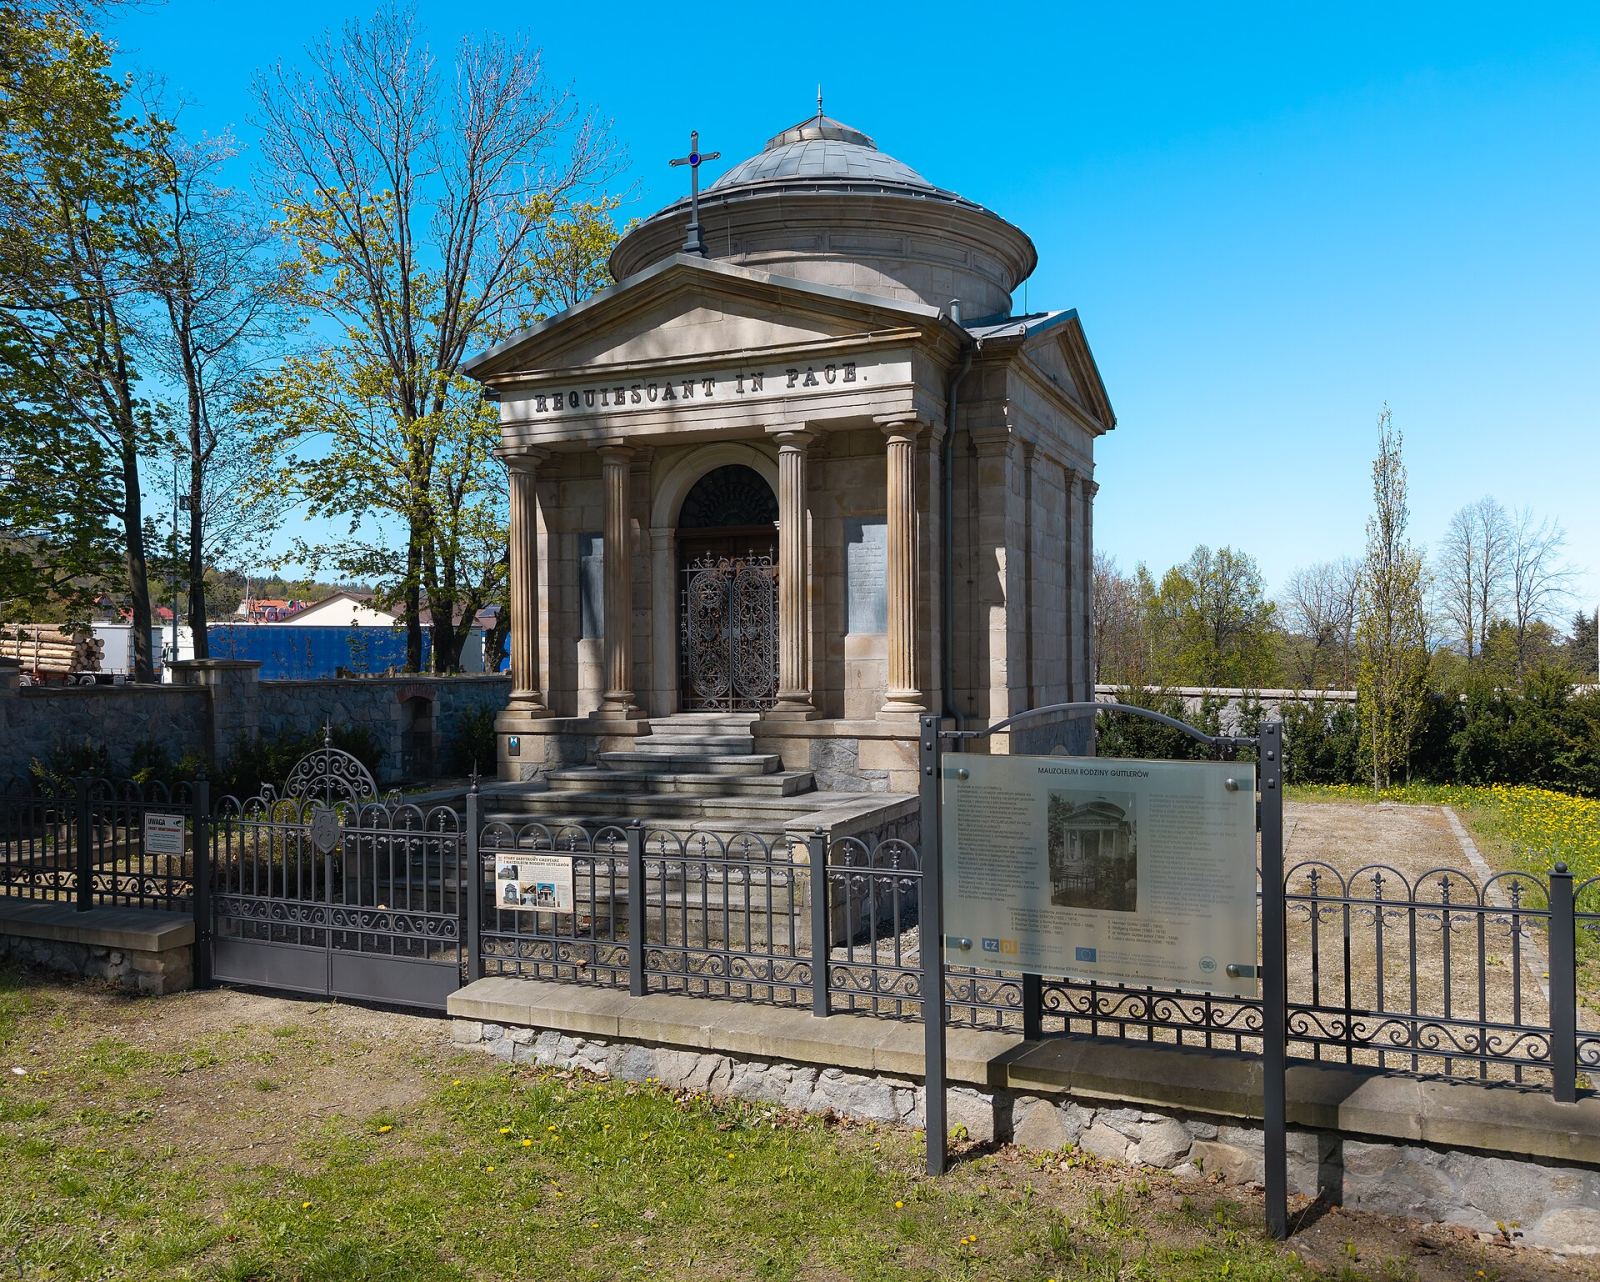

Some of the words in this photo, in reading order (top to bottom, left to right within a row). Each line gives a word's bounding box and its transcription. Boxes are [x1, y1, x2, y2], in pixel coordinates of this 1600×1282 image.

[535, 377, 716, 413] REQUIESCANT
[735, 371, 765, 394] IN
[785, 361, 868, 389] PACE.
[1037, 767, 1079, 776] MAUZOLEUM
[1079, 768, 1109, 777] RODZINY
[148, 818, 165, 826] UWAGA
